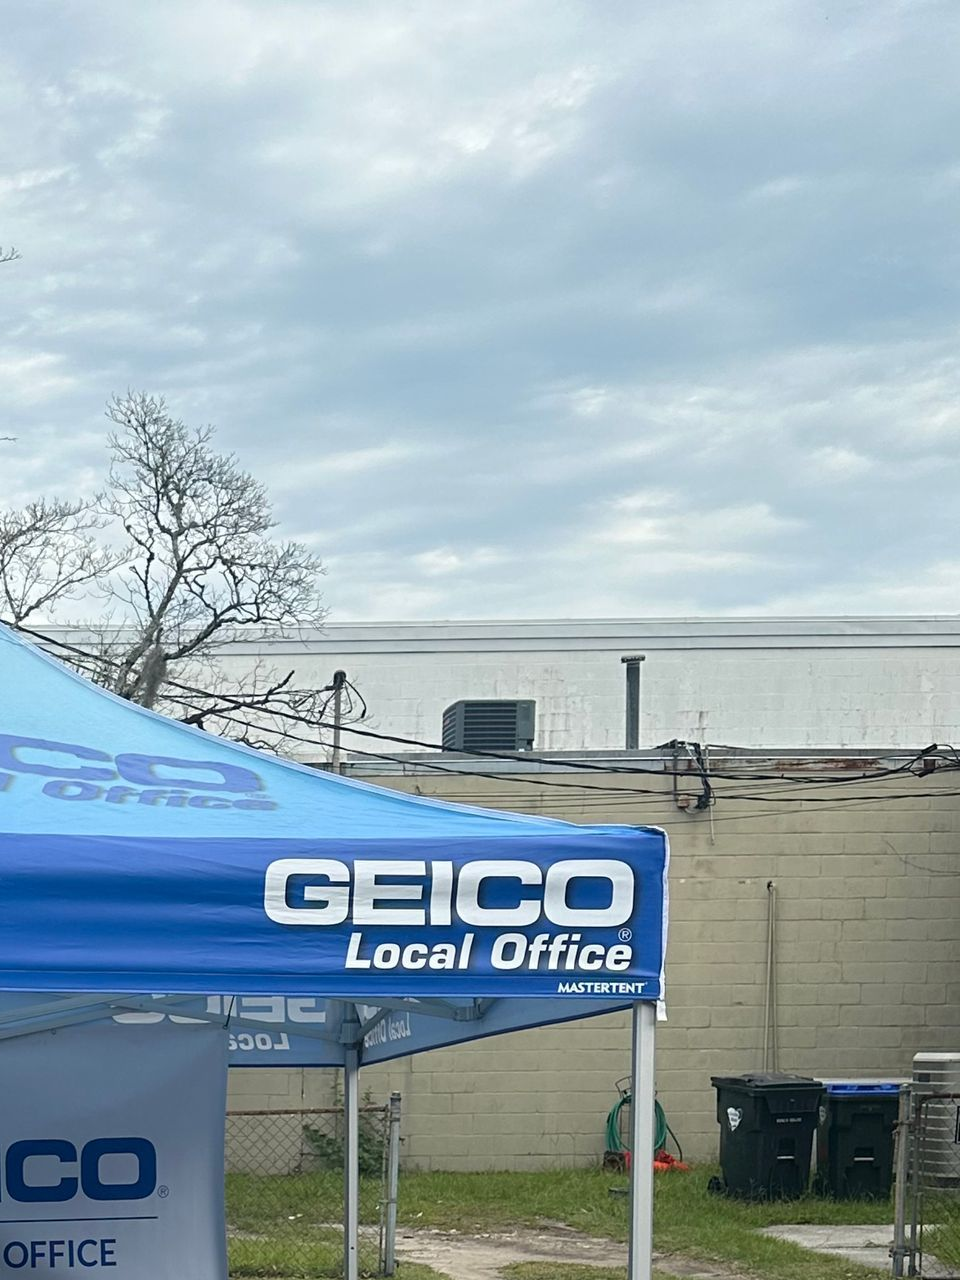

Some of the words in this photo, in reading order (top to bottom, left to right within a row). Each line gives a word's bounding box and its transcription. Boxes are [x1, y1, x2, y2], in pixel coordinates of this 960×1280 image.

[42, 779, 276, 811] Office
[263, 858, 635, 927] GEICO
[344, 932, 475, 970] Local
[490, 933, 633, 971] Office
[557, 982, 645, 994] MASTERTENT
[3, 1239, 117, 1269] OFFICE
